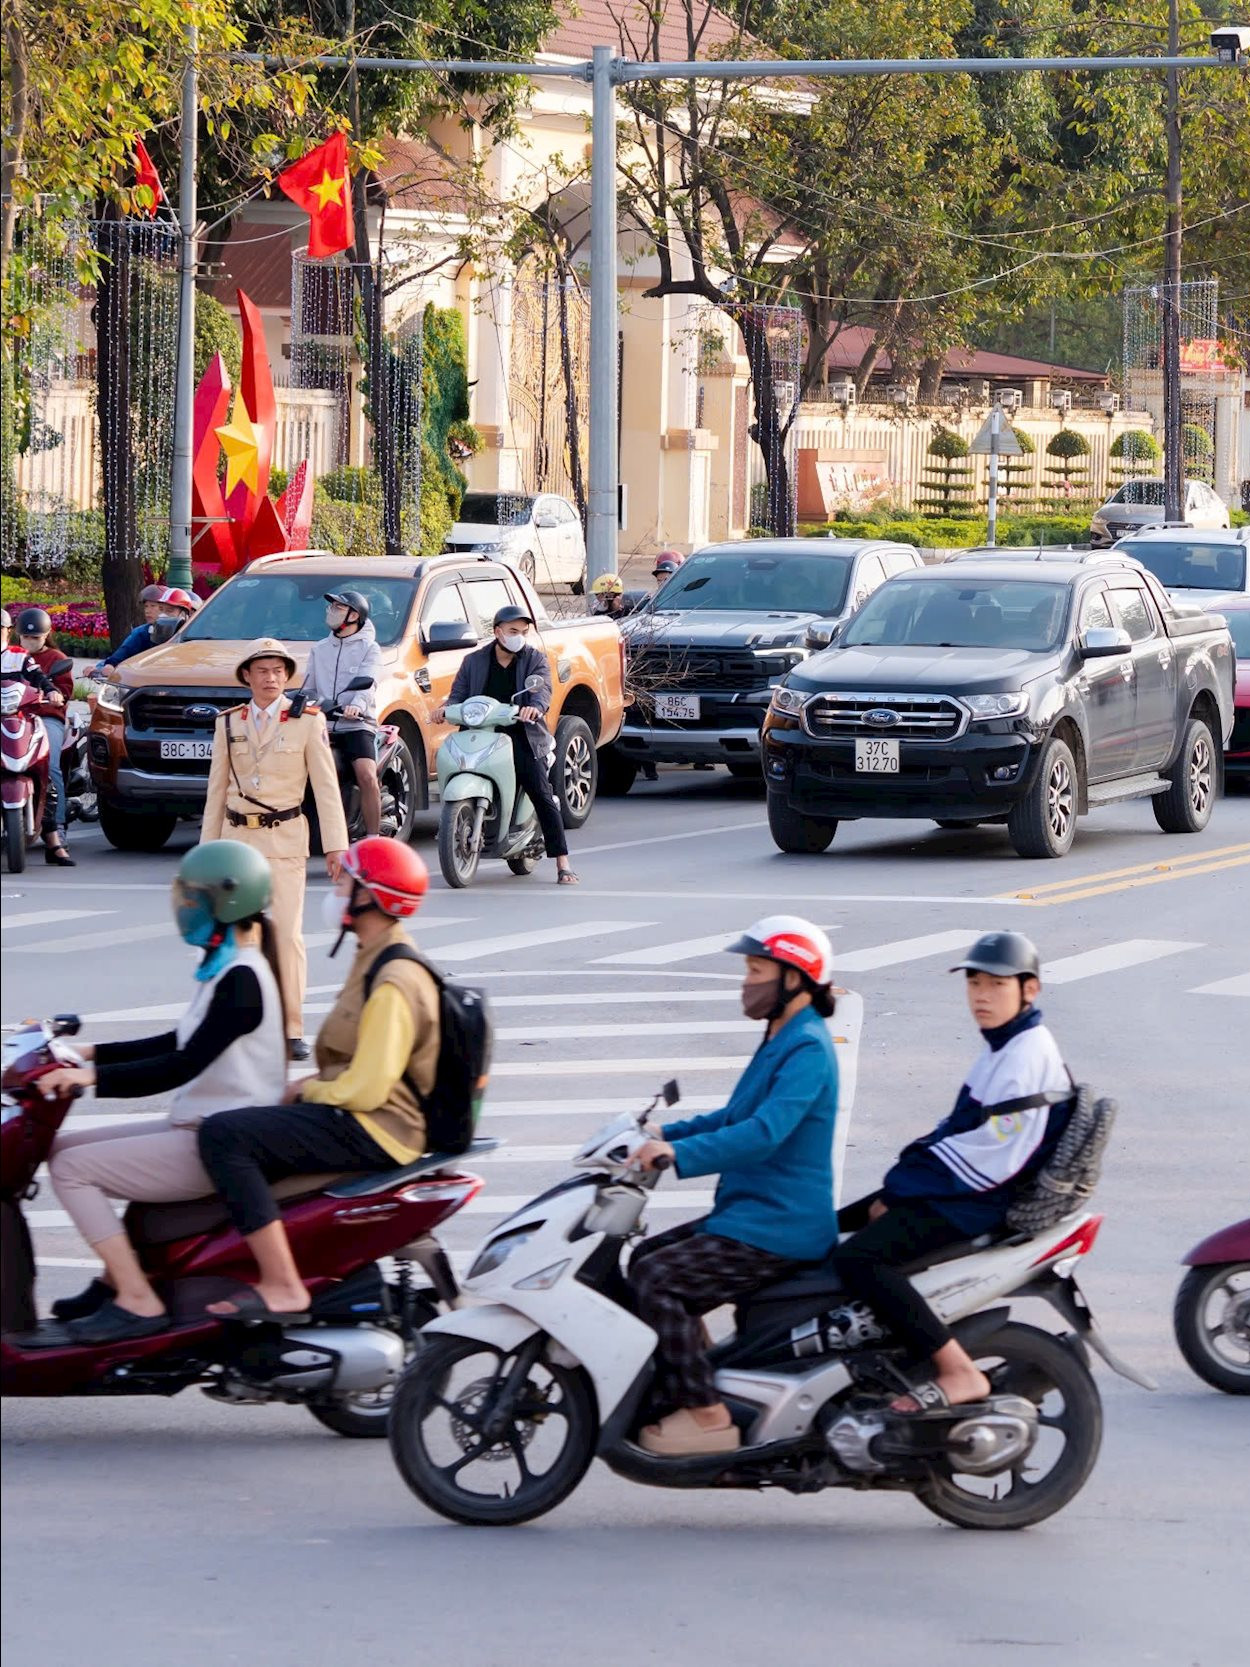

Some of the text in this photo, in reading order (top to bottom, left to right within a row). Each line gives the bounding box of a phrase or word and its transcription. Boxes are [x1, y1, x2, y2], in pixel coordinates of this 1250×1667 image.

[667, 696, 687, 707] 86C
[865, 741, 889, 756] 37C
[856, 756, 898, 771] 312.70
